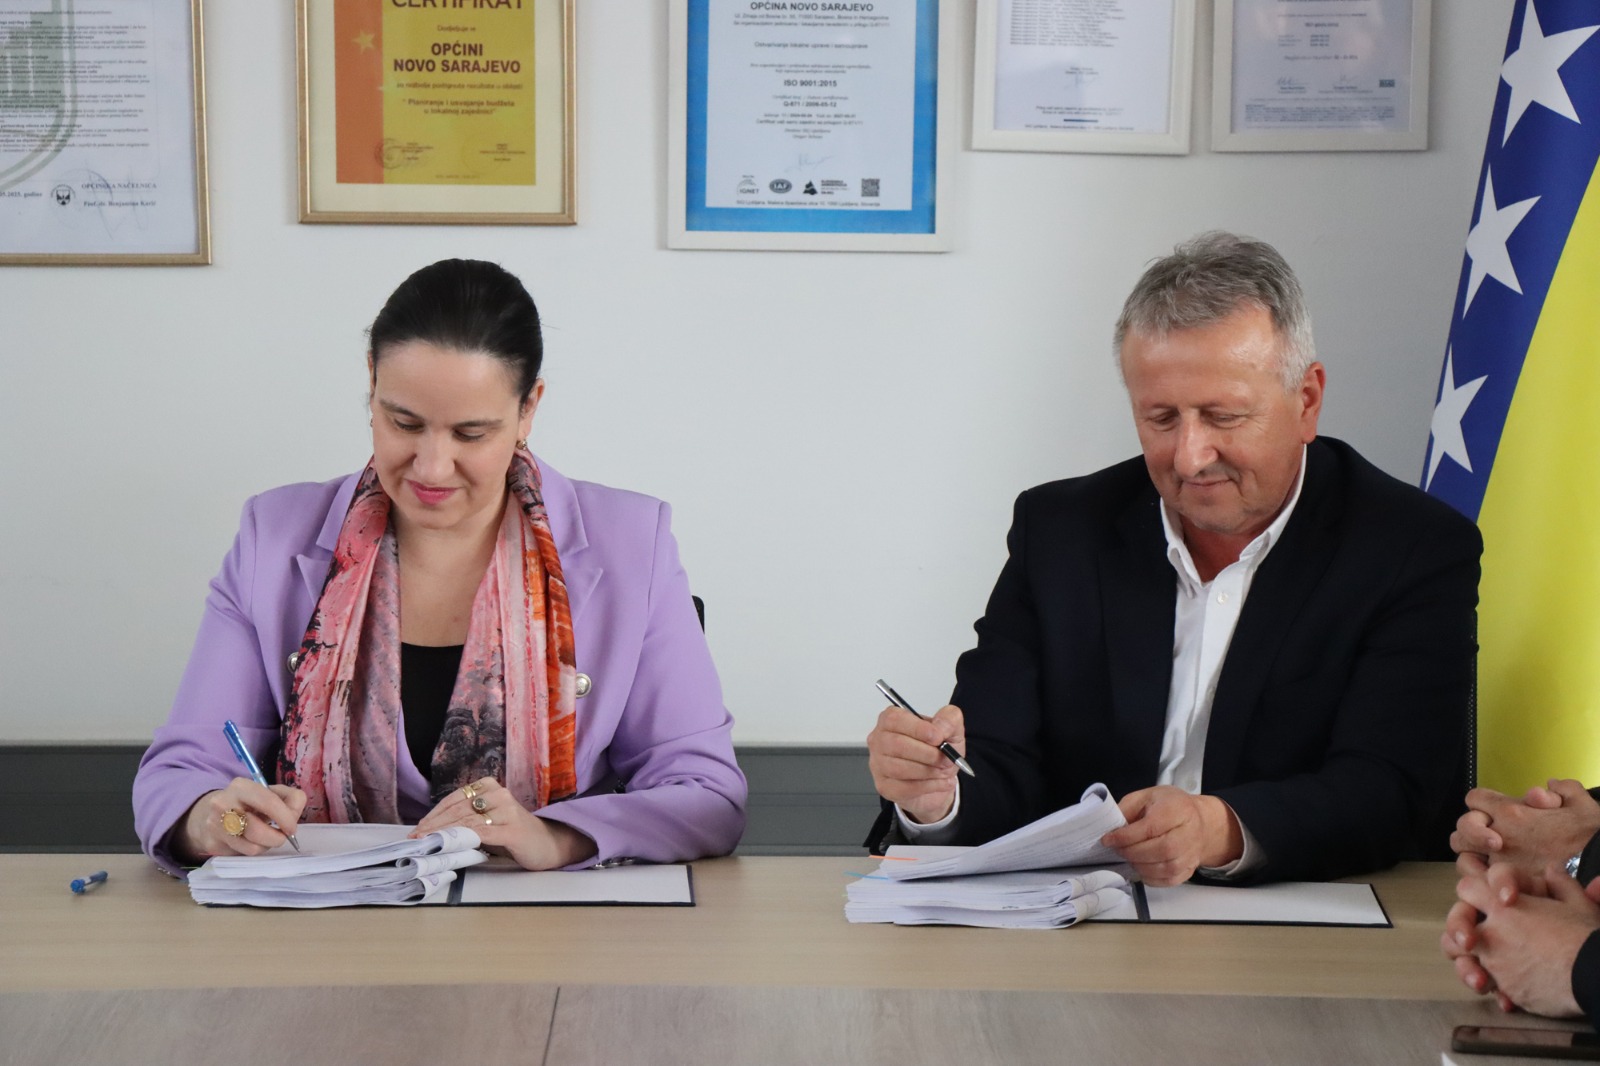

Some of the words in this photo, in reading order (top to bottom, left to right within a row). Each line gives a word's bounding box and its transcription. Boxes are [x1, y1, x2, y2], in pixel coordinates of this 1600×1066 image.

[750, 0, 787, 11] OPĆINA
[789, 2, 819, 11] NOVO
[820, 2, 874, 12] SARAJEVO
[431, 40, 483, 56] OPĆINI
[393, 59, 436, 72] NOVO
[441, 59, 521, 73] SARAJEVO
[783, 79, 798, 87] ISO
[799, 79, 838, 87] 9001:2015
